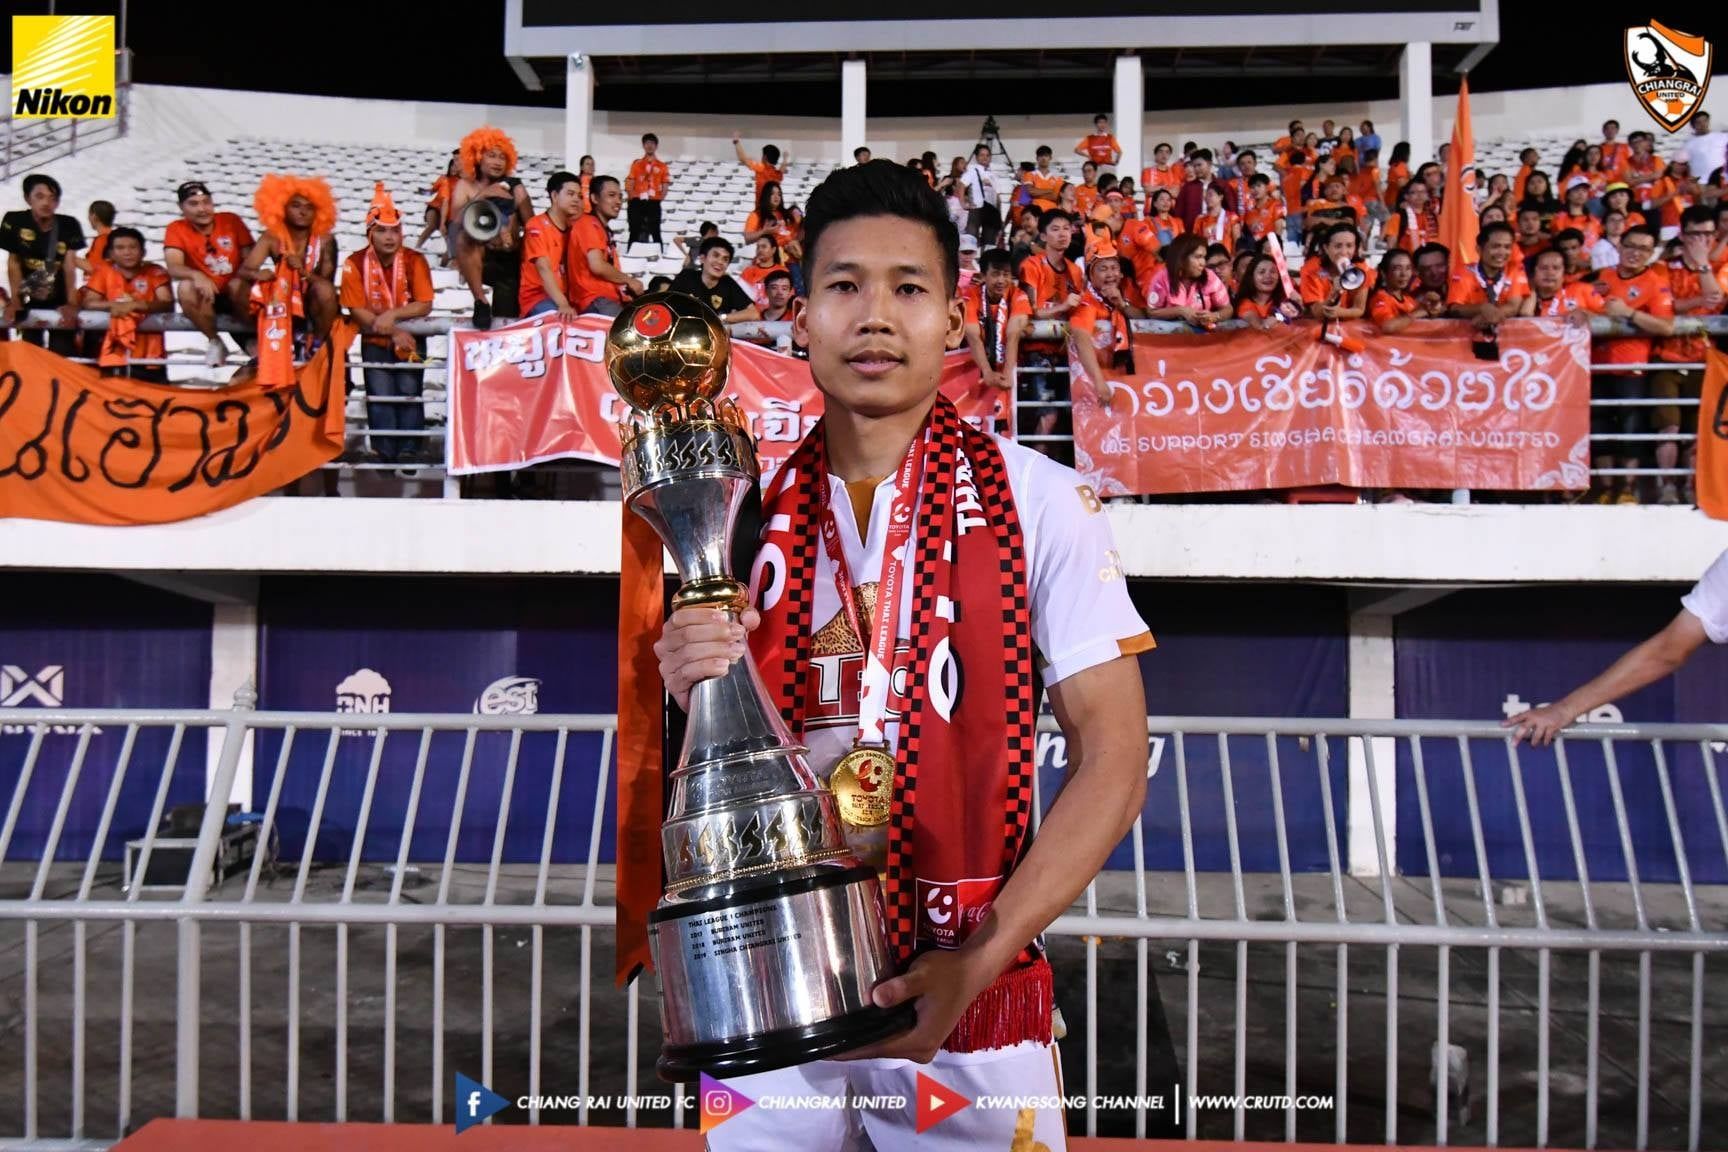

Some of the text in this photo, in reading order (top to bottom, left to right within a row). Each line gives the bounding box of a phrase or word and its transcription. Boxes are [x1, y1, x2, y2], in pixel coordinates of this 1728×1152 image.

[1100, 436, 1132, 455] WE
[1137, 432, 1243, 453] SUPPORT
[1249, 425, 1336, 448] SINGHA
[1470, 431, 1560, 449] UNITED
[901, 458, 913, 489] LEAGUE
[877, 560, 897, 660] TOYOTA THAI LEAGUE
[851, 794, 886, 804] TOYOTA
[704, 915, 728, 925] LEAGUE
[735, 904, 777, 919] CHAMPIONS
[740, 919, 764, 929] UNITED
[742, 929, 766, 940] UNITED
